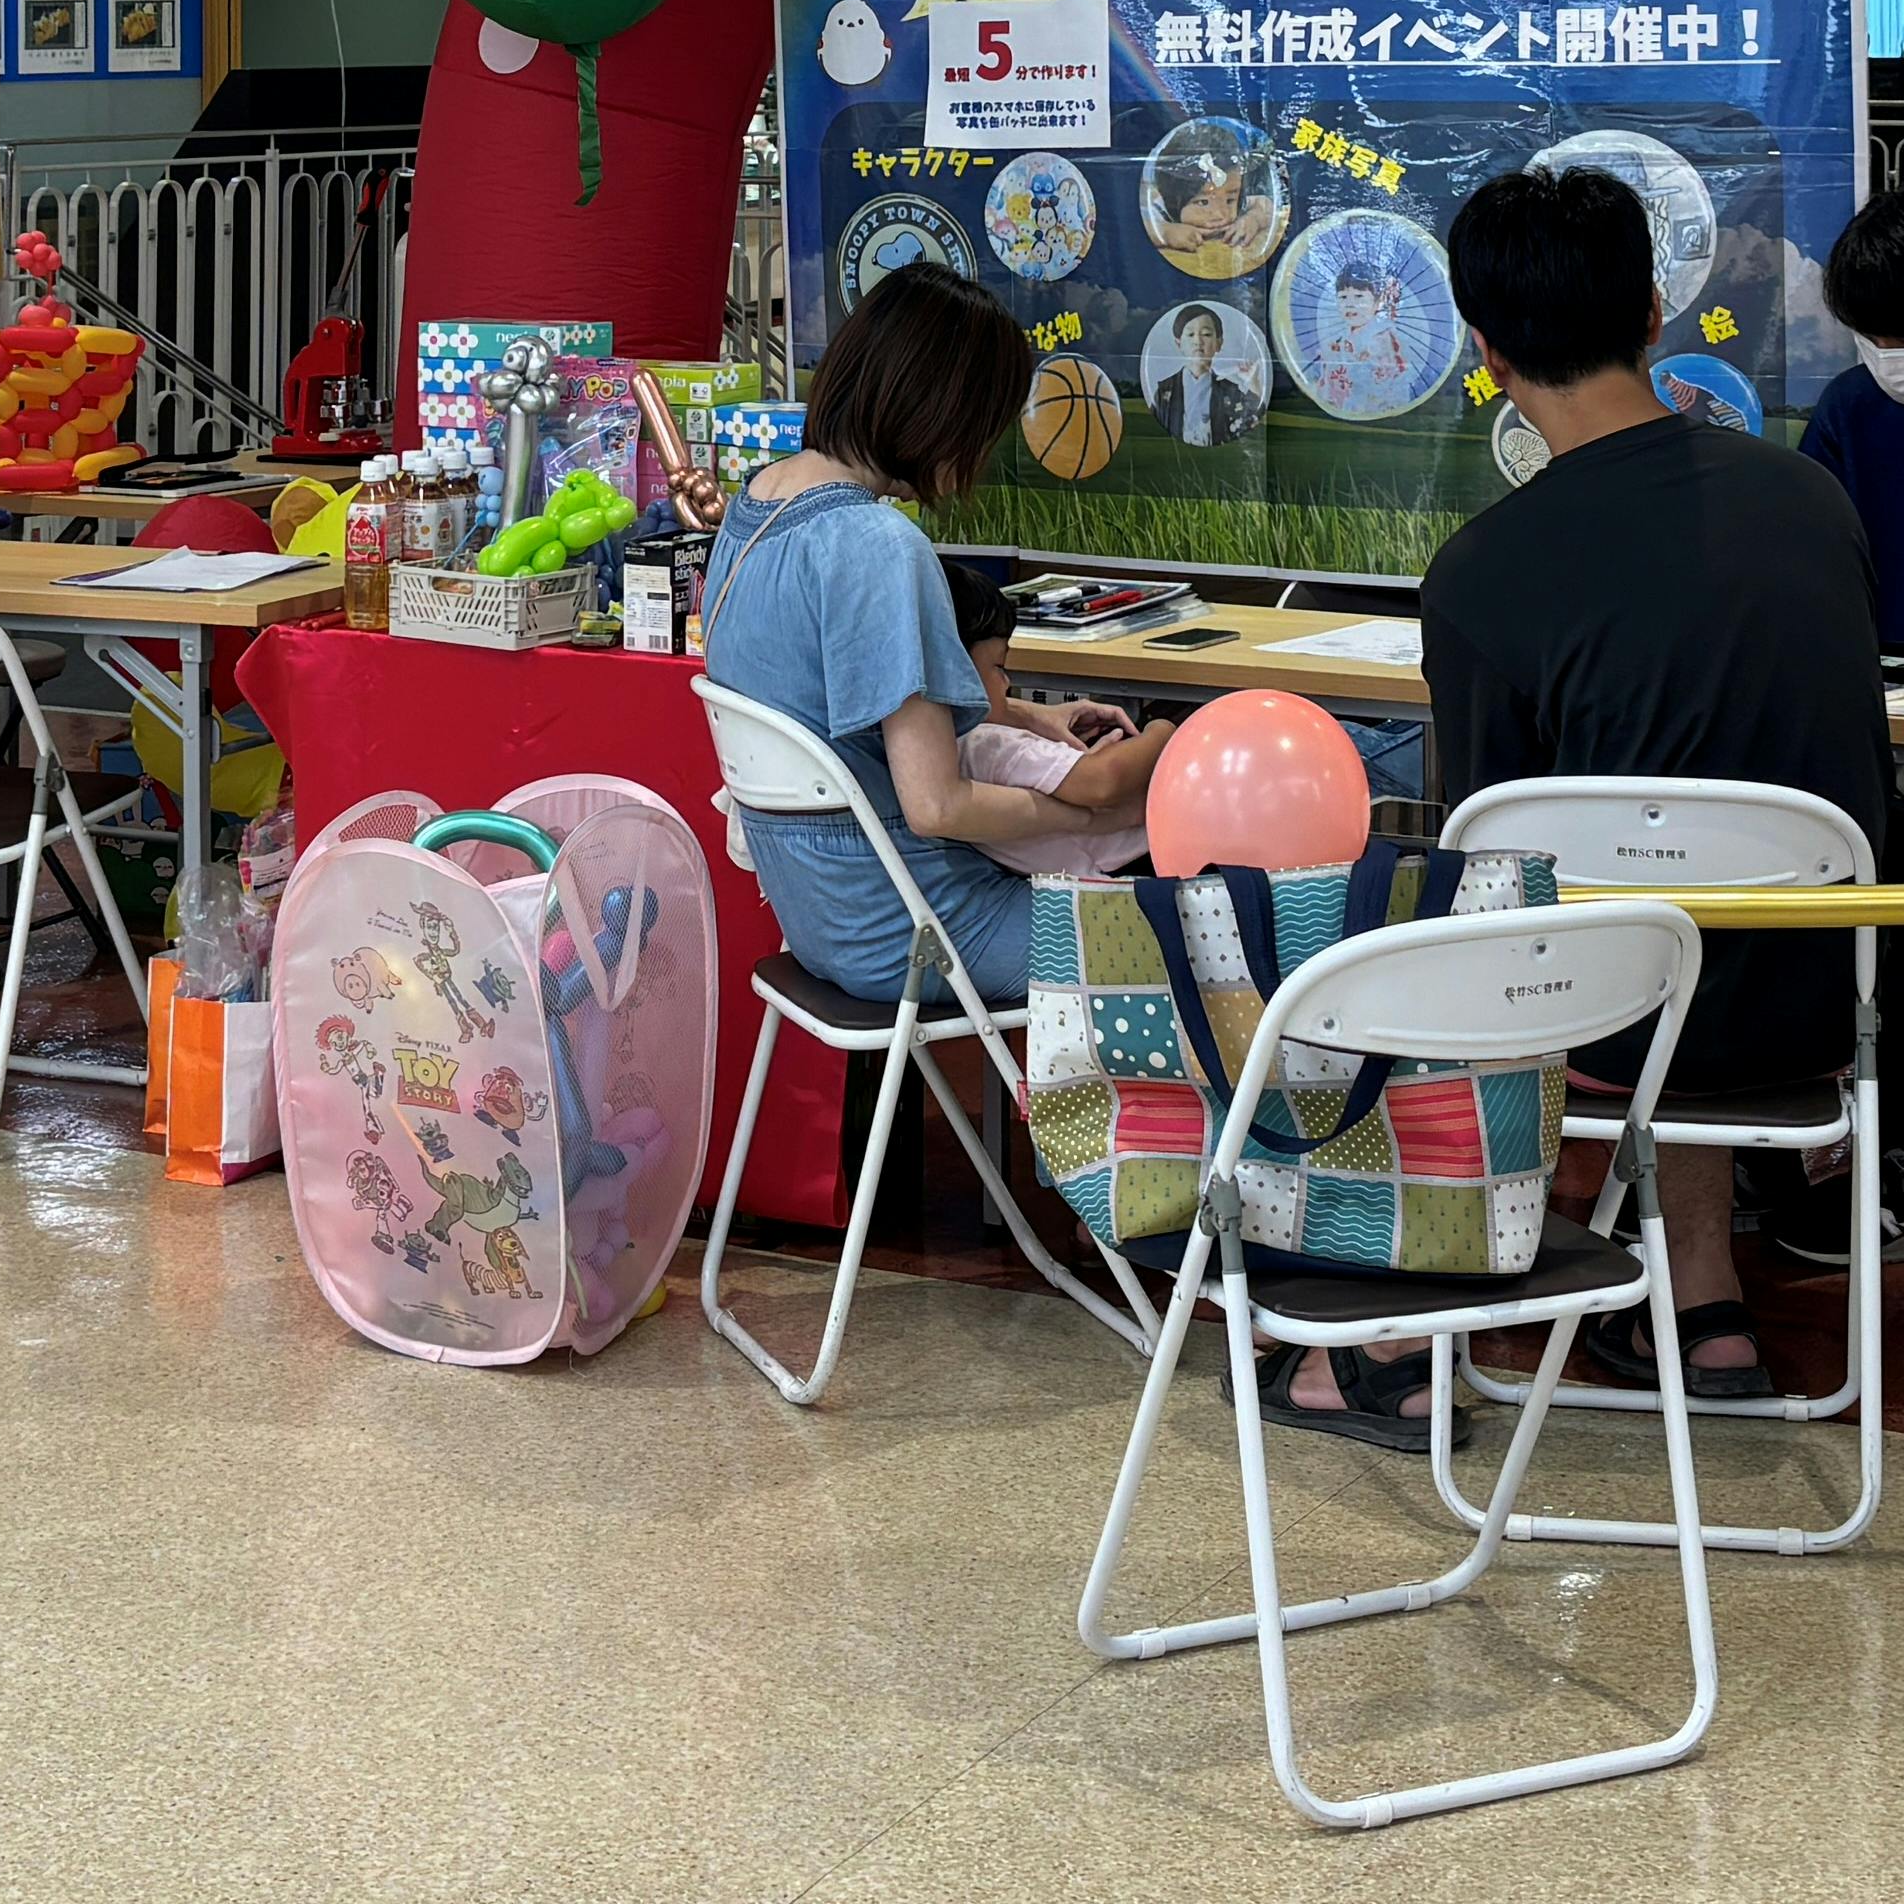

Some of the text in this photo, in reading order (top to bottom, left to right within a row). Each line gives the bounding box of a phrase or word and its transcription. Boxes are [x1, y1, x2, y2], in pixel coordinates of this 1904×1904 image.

[1154, 7, 1761, 63] 無料作成イベント開催中！
[852, 147, 995, 177] キャラクター
[1290, 117, 1406, 195] 家族写真
[846, 212, 881, 289] SNOOPY
[884, 206, 941, 232] TOWN
[1699, 306, 1740, 345] 絵
[674, 545, 708, 567] Blendy
[392, 1047, 461, 1090] TOY
[404, 1085, 454, 1107] STORY
